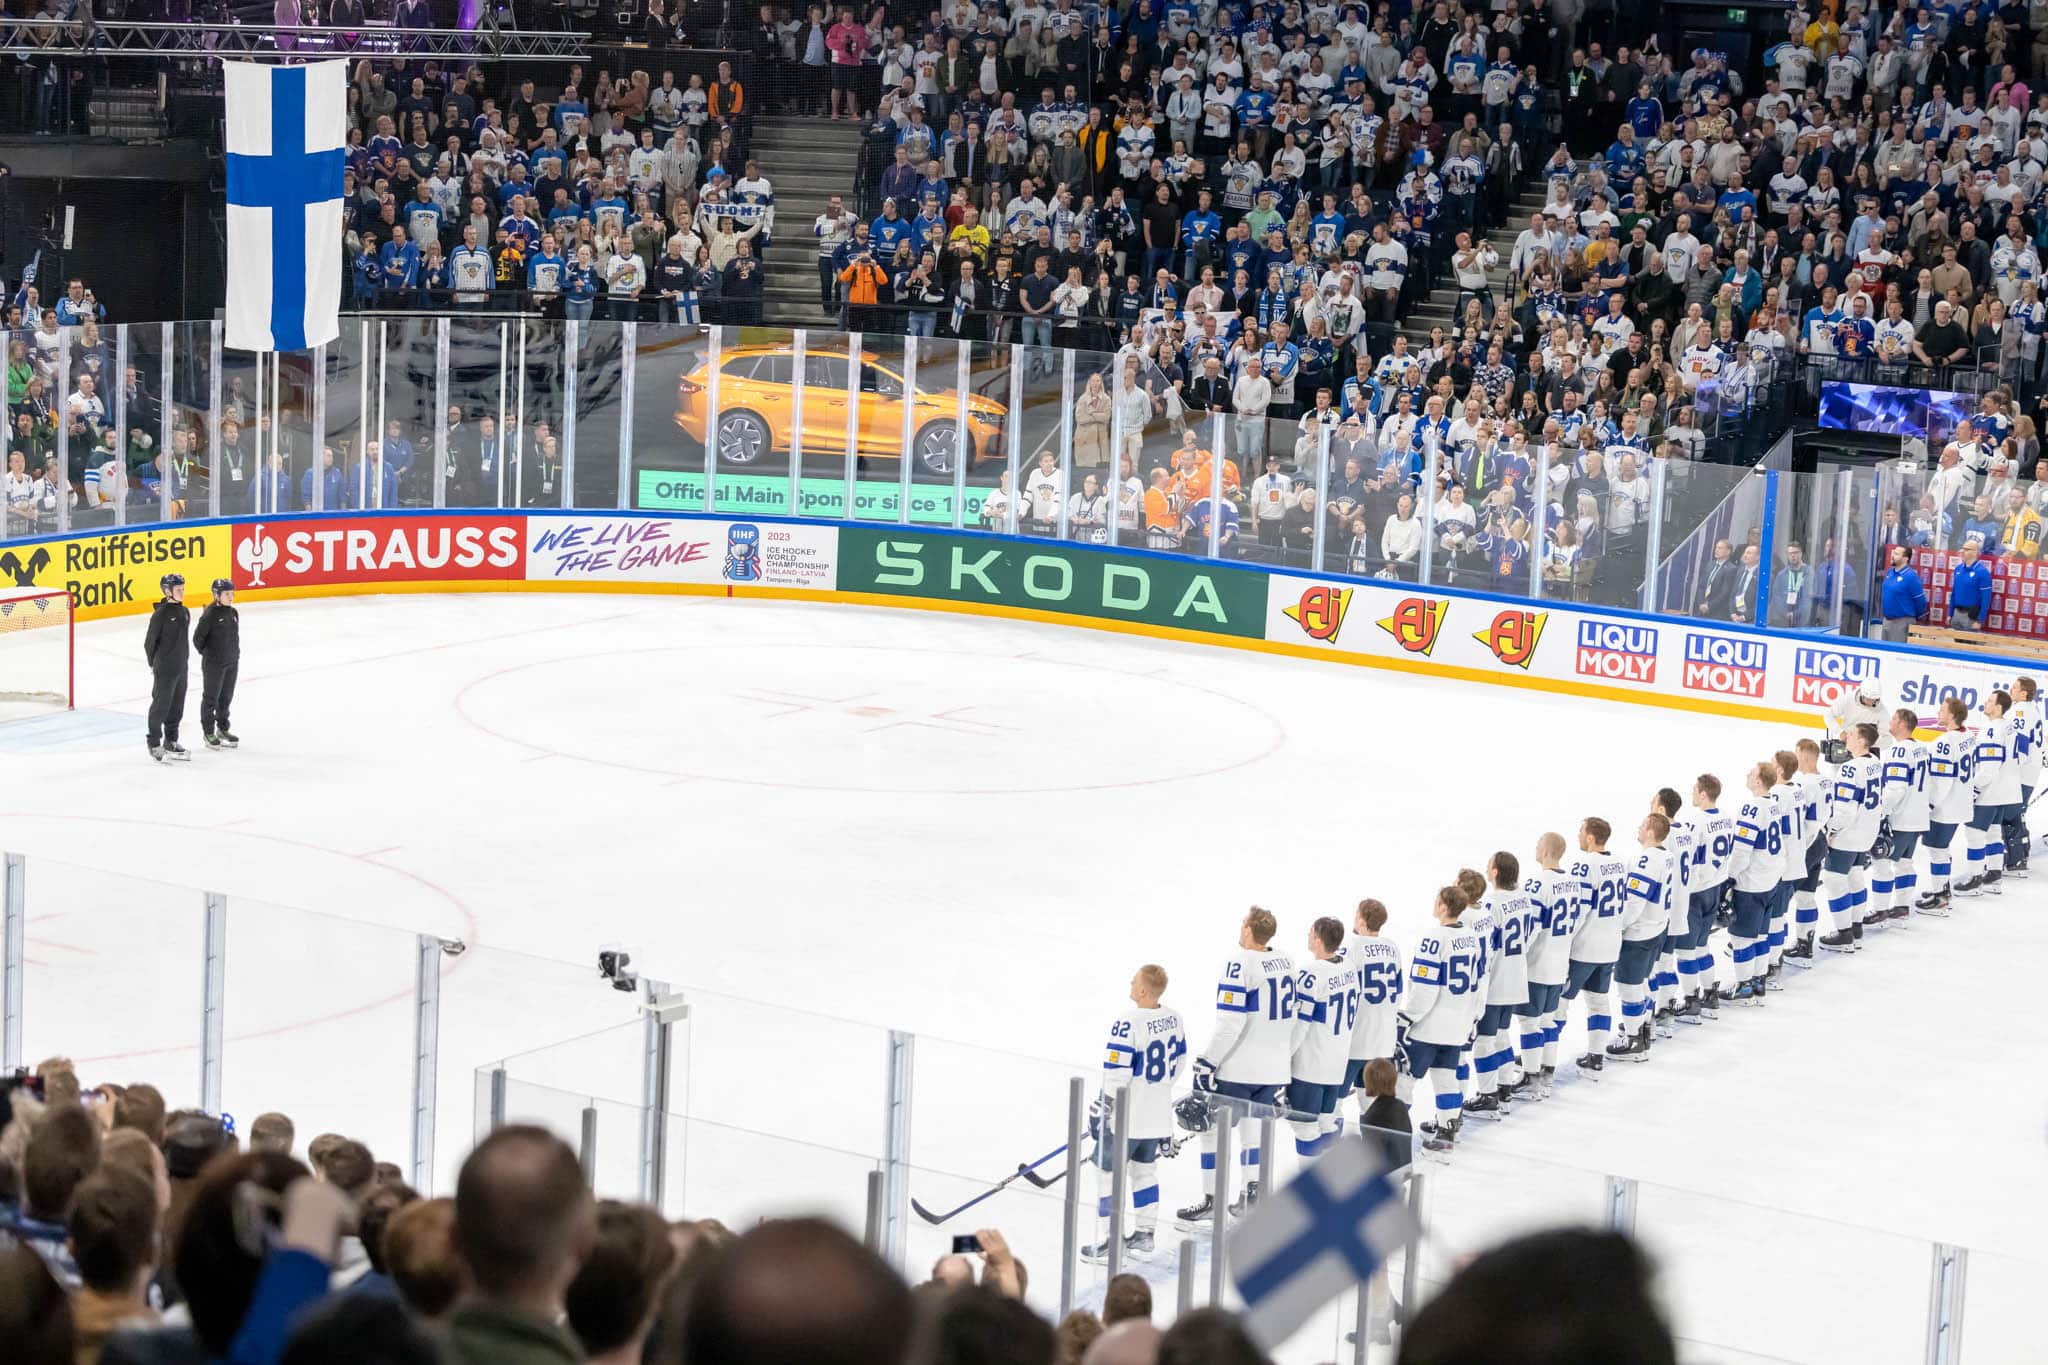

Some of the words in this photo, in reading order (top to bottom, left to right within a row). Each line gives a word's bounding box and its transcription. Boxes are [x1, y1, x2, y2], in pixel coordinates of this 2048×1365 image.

[655, 481, 730, 501] Offical
[736, 486, 784, 504] Main
[799, 489, 876, 509] Sponor
[881, 493, 936, 512] sice
[532, 524, 593, 553] WE
[590, 521, 672, 545] LIVE
[732, 529, 755, 540] IIHF
[767, 532, 791, 541] 2023
[66, 532, 205, 572] Raiffeisen
[285, 527, 518, 573] STRAUSS
[554, 549, 617, 576] THE
[617, 542, 711, 571] GAME
[766, 554, 797, 562] WORLD
[782, 548, 817, 556] HOCKEY
[766, 561, 830, 570] CHAMPIONSHIP
[69, 573, 134, 608] Bank
[1580, 621, 1657, 654] LIQUI
[1687, 635, 1766, 669] LIQUI
[1579, 651, 1655, 681] MOLY
[1798, 649, 1879, 683] LIQUI
[1686, 665, 1764, 696] MOLY
[2013, 718, 2026, 730] 33
[1987, 728, 1994, 739] 4
[1891, 746, 1906, 759] 70
[1936, 742, 1951, 755] 96
[1741, 804, 1758, 819] 84
[1571, 862, 1589, 877] 29
[1638, 855, 1649, 869] 2
[1524, 878, 1542, 894] 23
[1420, 938, 1440, 955] 50
[1226, 961, 1242, 979] 12
[1297, 969, 1317, 989] 76
[1266, 974, 1294, 1020] 12
[1328, 988, 1358, 1036] 76
[1111, 1020, 1131, 1038] 82
[1145, 1034, 1180, 1084] 82
